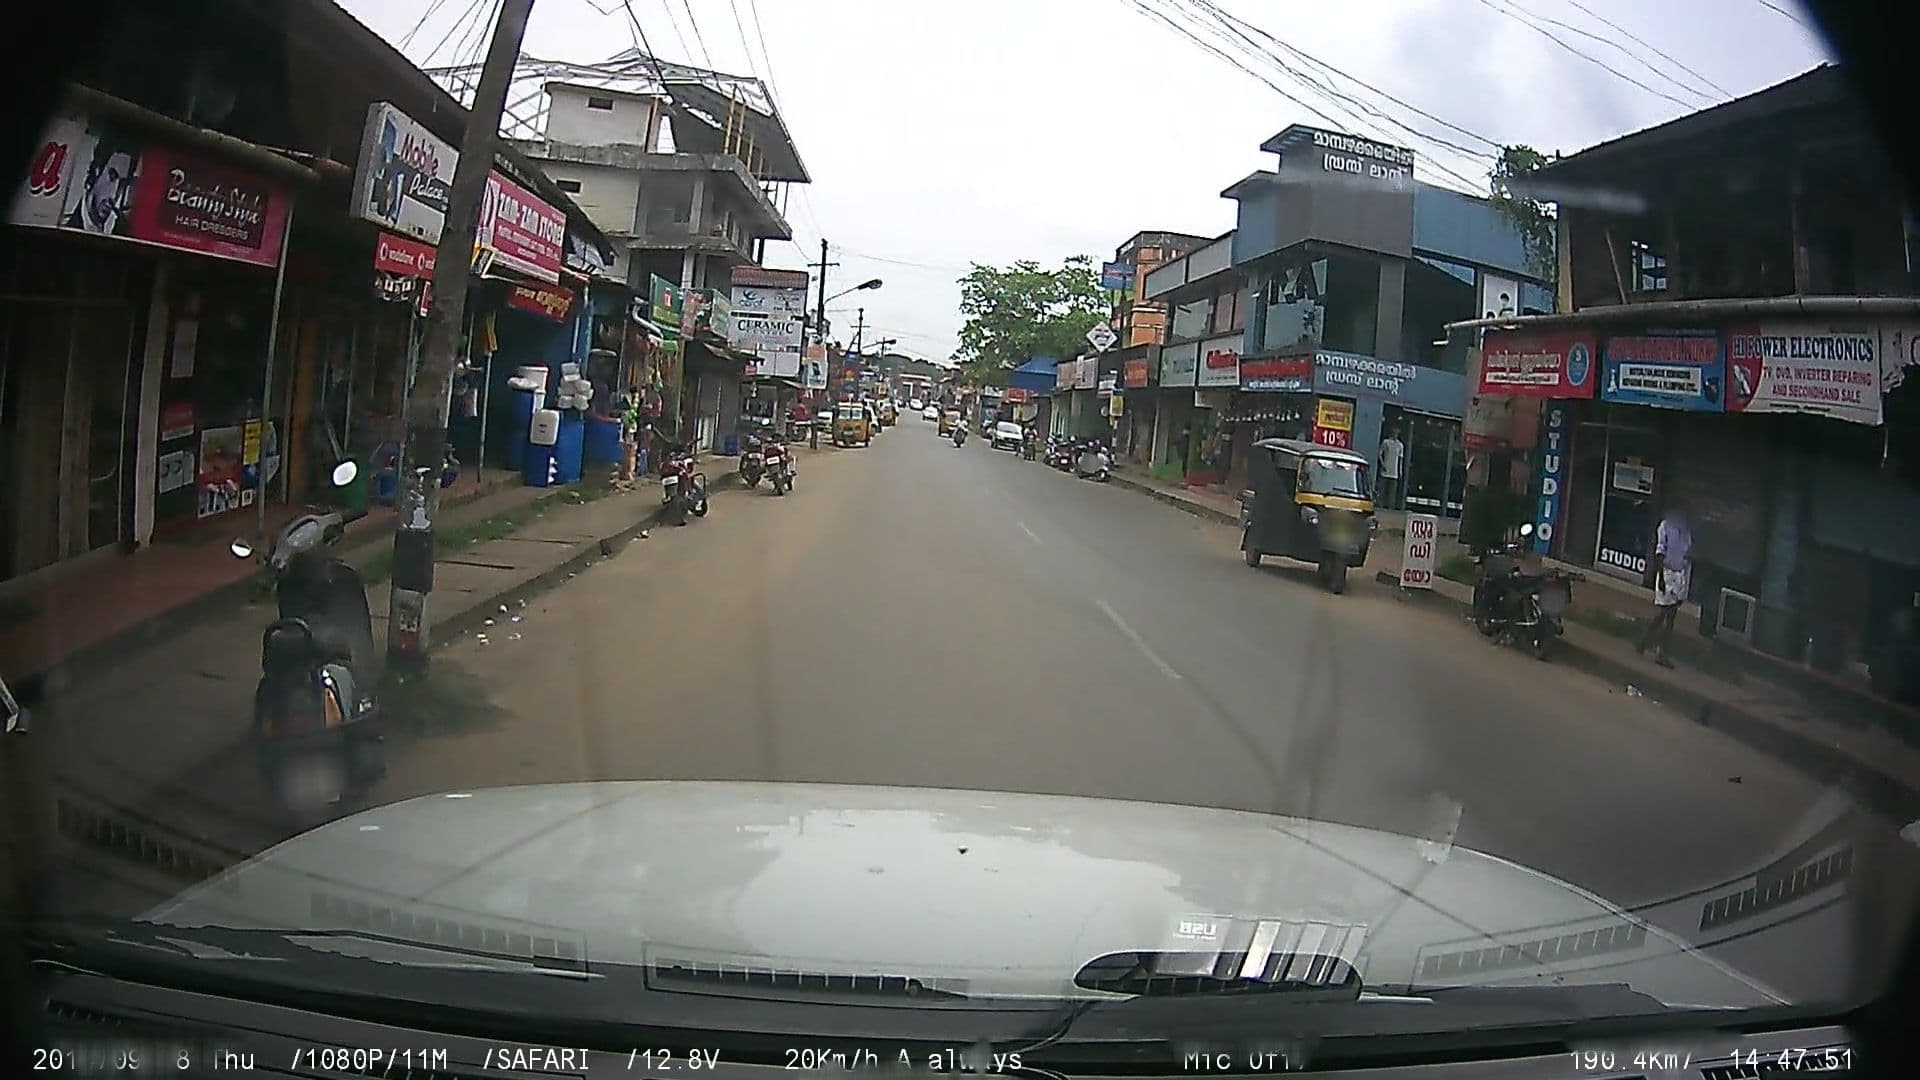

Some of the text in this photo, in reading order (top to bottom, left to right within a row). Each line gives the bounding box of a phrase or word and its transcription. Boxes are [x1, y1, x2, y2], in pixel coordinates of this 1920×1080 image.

[401, 133, 439, 179] Mobile
[408, 172, 444, 201] Palace
[175, 215, 249, 241] HAIR DRESSERS
[737, 319, 795, 335] CERAMIC
[1732, 335, 1745, 360] HI
[1747, 335, 1788, 360] POWER
[1790, 336, 1875, 362] ELECTRONICS
[1794, 367, 1831, 382] INVERTER
[1772, 384, 1861, 404] AND SECONDHAND SALE
[1322, 429, 1347, 447] 10%
[1537, 410, 1562, 541] STUDIO
[1601, 547, 1647, 573] STUDIO
